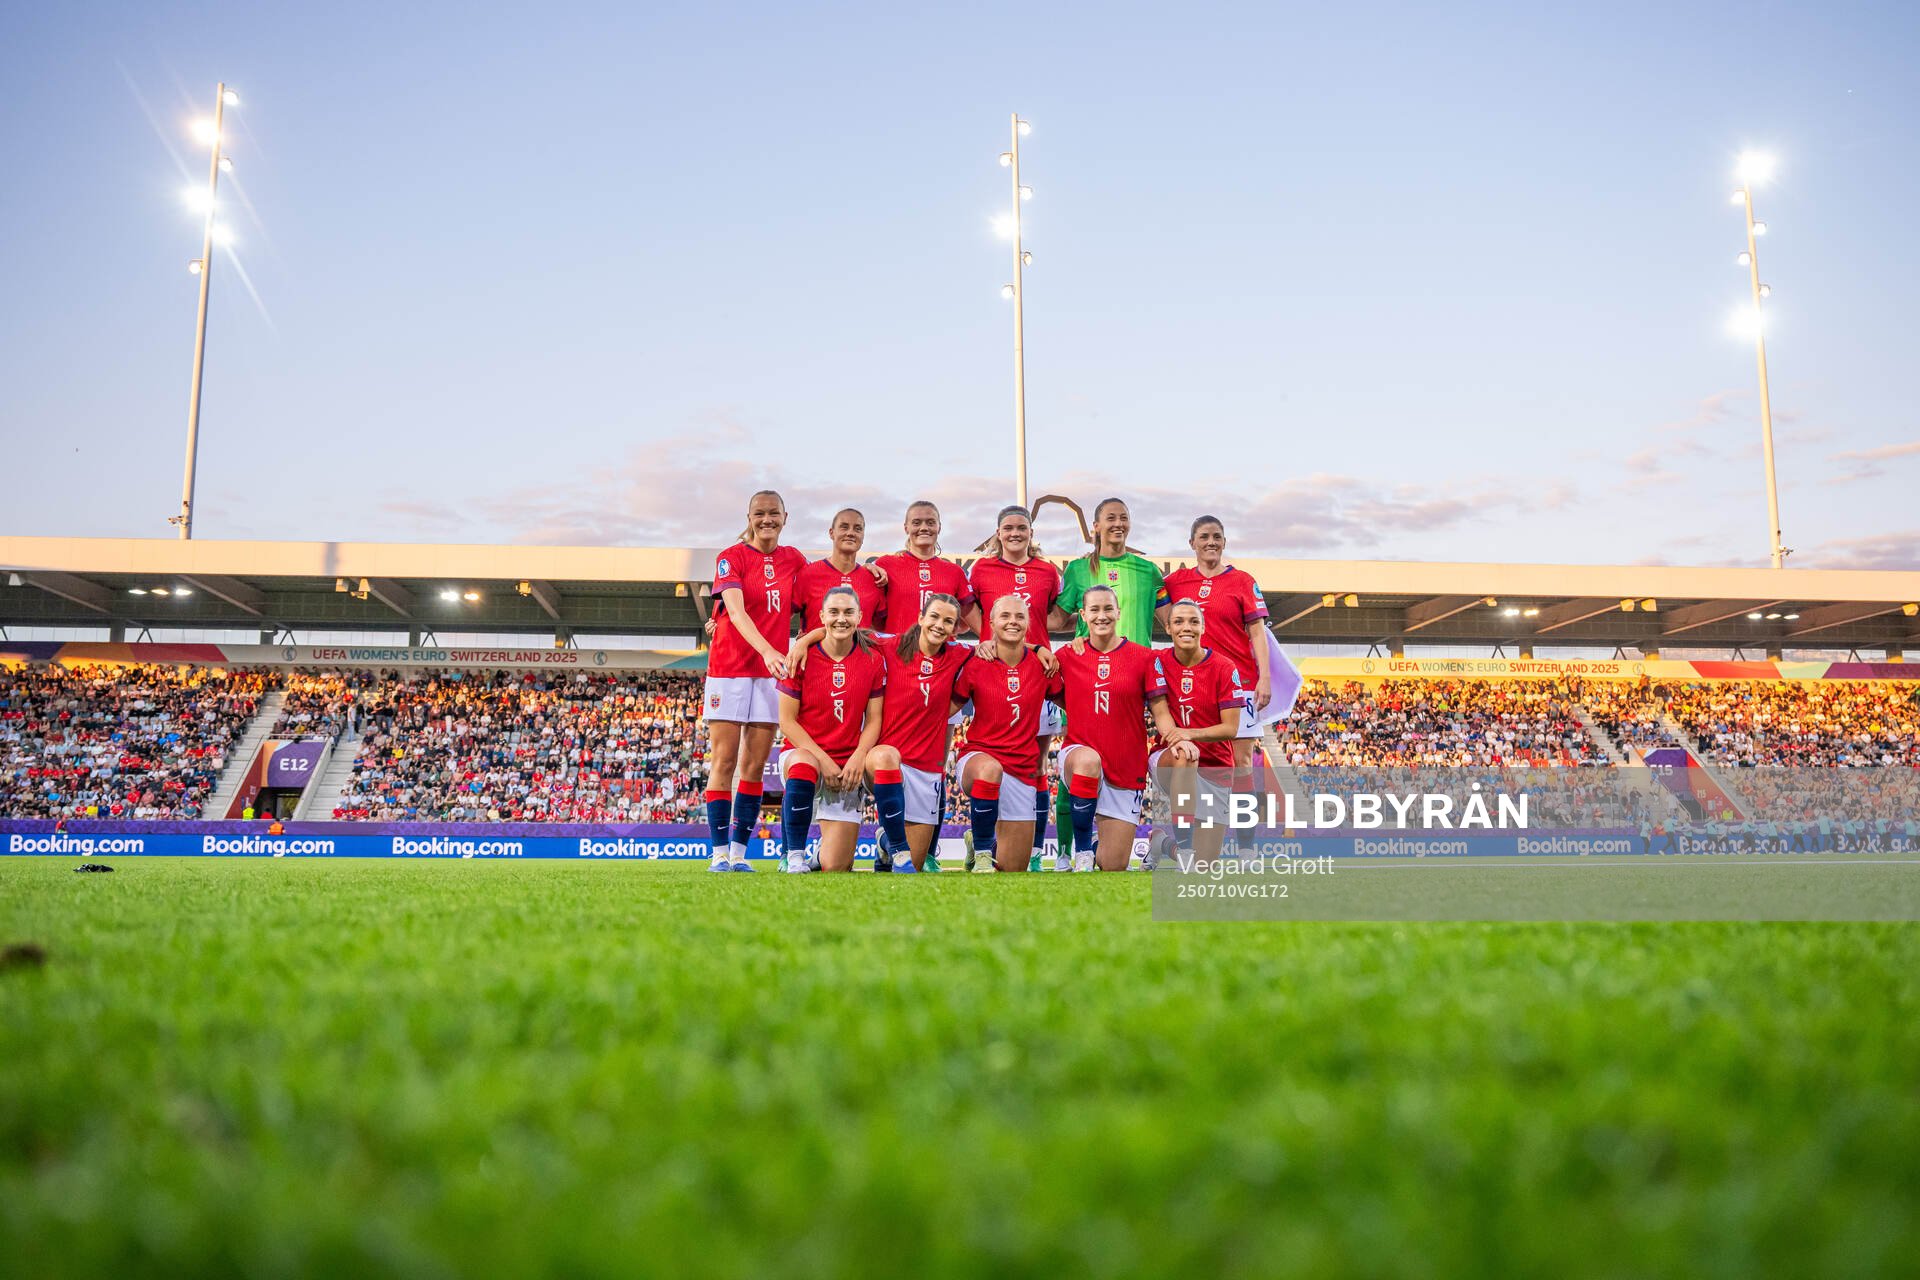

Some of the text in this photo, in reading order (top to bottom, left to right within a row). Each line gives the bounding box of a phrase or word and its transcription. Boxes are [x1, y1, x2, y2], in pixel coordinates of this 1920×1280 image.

[766, 589, 781, 614] 18
[312, 649, 577, 663] UEFA WOMEN'S EURO SWITZERLAND 2025
[1389, 661, 1619, 674] UEFA WOMEN'S EURO SWITZERLAND 2025
[920, 682, 931, 707] 4
[1094, 691, 1109, 715] 19
[833, 699, 844, 724] 8
[1179, 704, 1194, 727] 17
[279, 758, 309, 771] E12
[763, 762, 779, 775] E1
[9, 834, 144, 856] Booking.com
[203, 835, 335, 857] Booking.com
[392, 836, 522, 858] Booking.com
[579, 838, 707, 860] Booking.com
[1354, 838, 1468, 858] Booking.com
[1517, 836, 1631, 856] Booking.com
